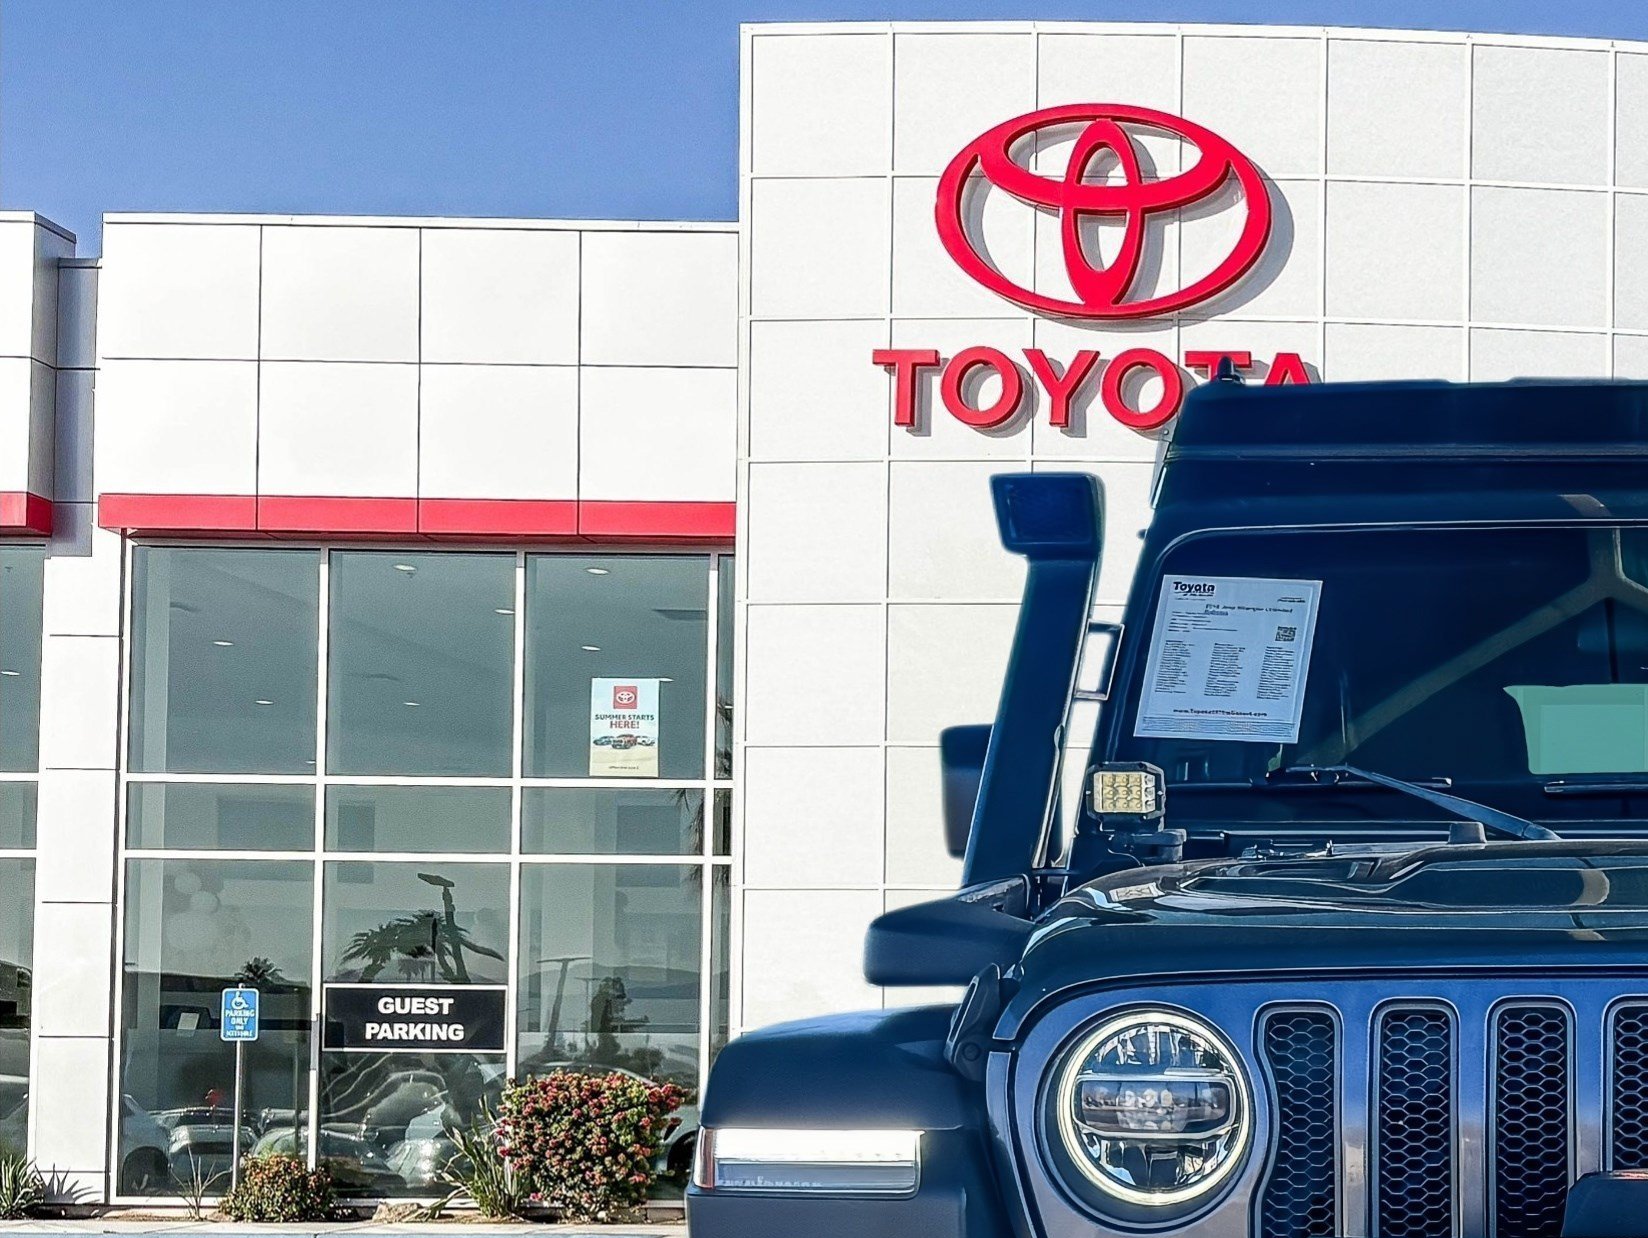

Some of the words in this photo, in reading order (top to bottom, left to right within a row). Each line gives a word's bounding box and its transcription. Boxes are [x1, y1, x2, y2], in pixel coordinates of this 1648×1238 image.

[1173, 581, 1215, 593] Toyota
[609, 721, 640, 729] HERE!
[378, 997, 454, 1014] GUEST
[231, 1017, 249, 1025] ONLY
[365, 1023, 464, 1041] PARKING
